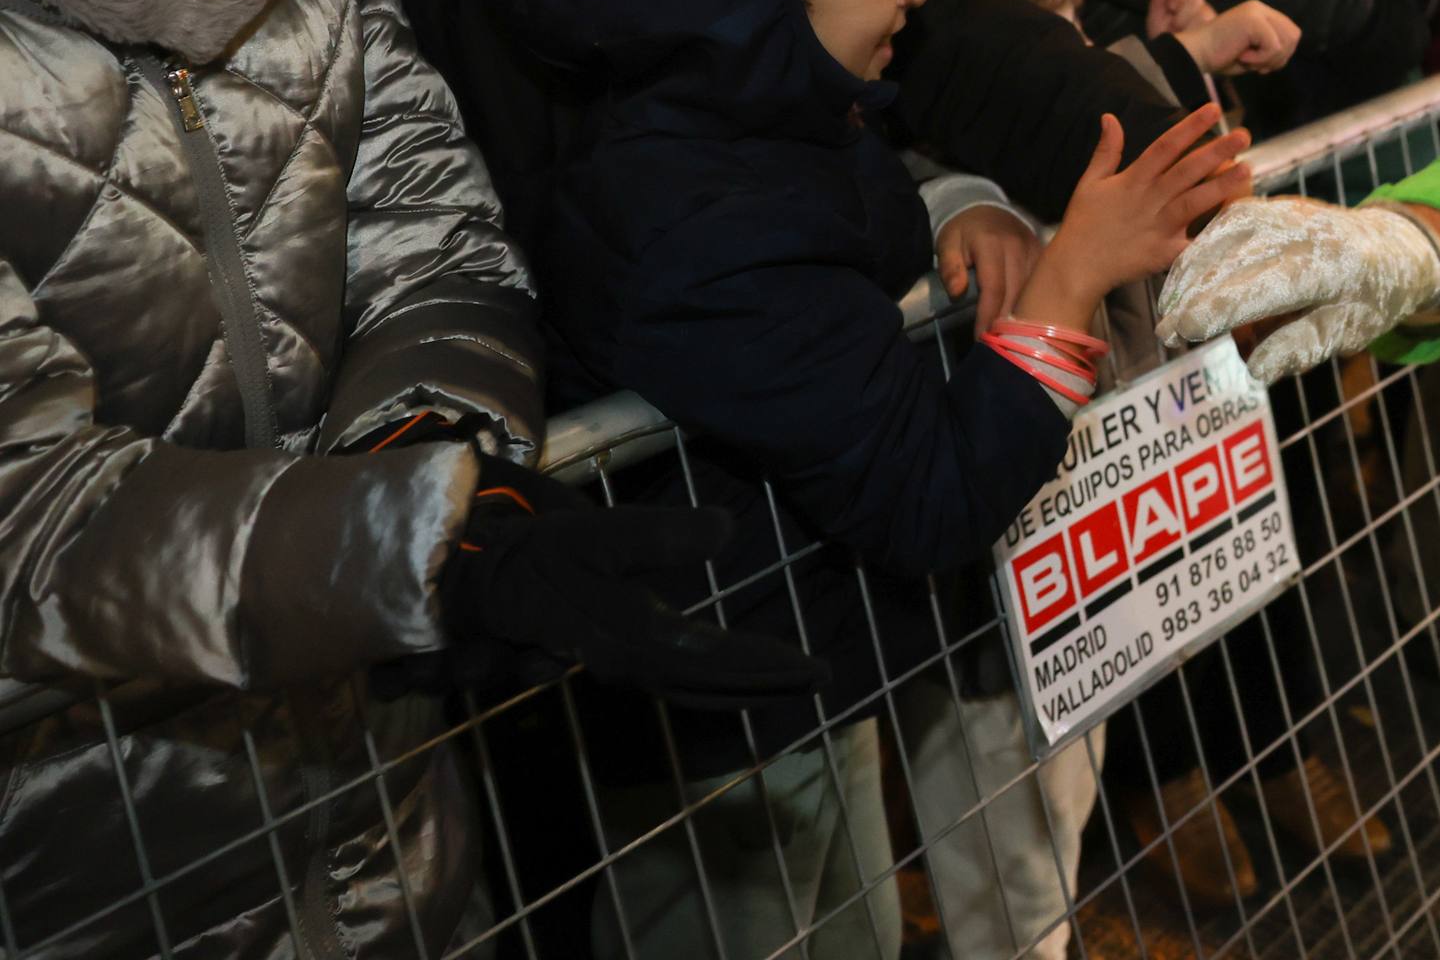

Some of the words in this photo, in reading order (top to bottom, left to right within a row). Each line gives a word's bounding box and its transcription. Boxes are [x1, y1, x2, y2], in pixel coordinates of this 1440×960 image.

[1006, 506, 1036, 547] DE
[1040, 454, 1134, 528] EQUIPOS
[1139, 425, 1193, 471] PARA
[1196, 393, 1259, 438] OBRAS
[1057, 405, 1141, 478] UILER
[1145, 389, 1161, 424] Y
[1019, 433, 1267, 618] BLAPE
[1034, 624, 1107, 692] MADRID
[1155, 574, 1181, 607] 91
[1189, 548, 1227, 587] 876
[1232, 529, 1256, 560] 88
[1261, 511, 1282, 542] 50
[1042, 632, 1154, 723] VALLADOLID
[1161, 601, 1202, 641] 983
[1207, 580, 1233, 612] 36
[1238, 563, 1262, 593] 04
[1267, 543, 1290, 573] 32
